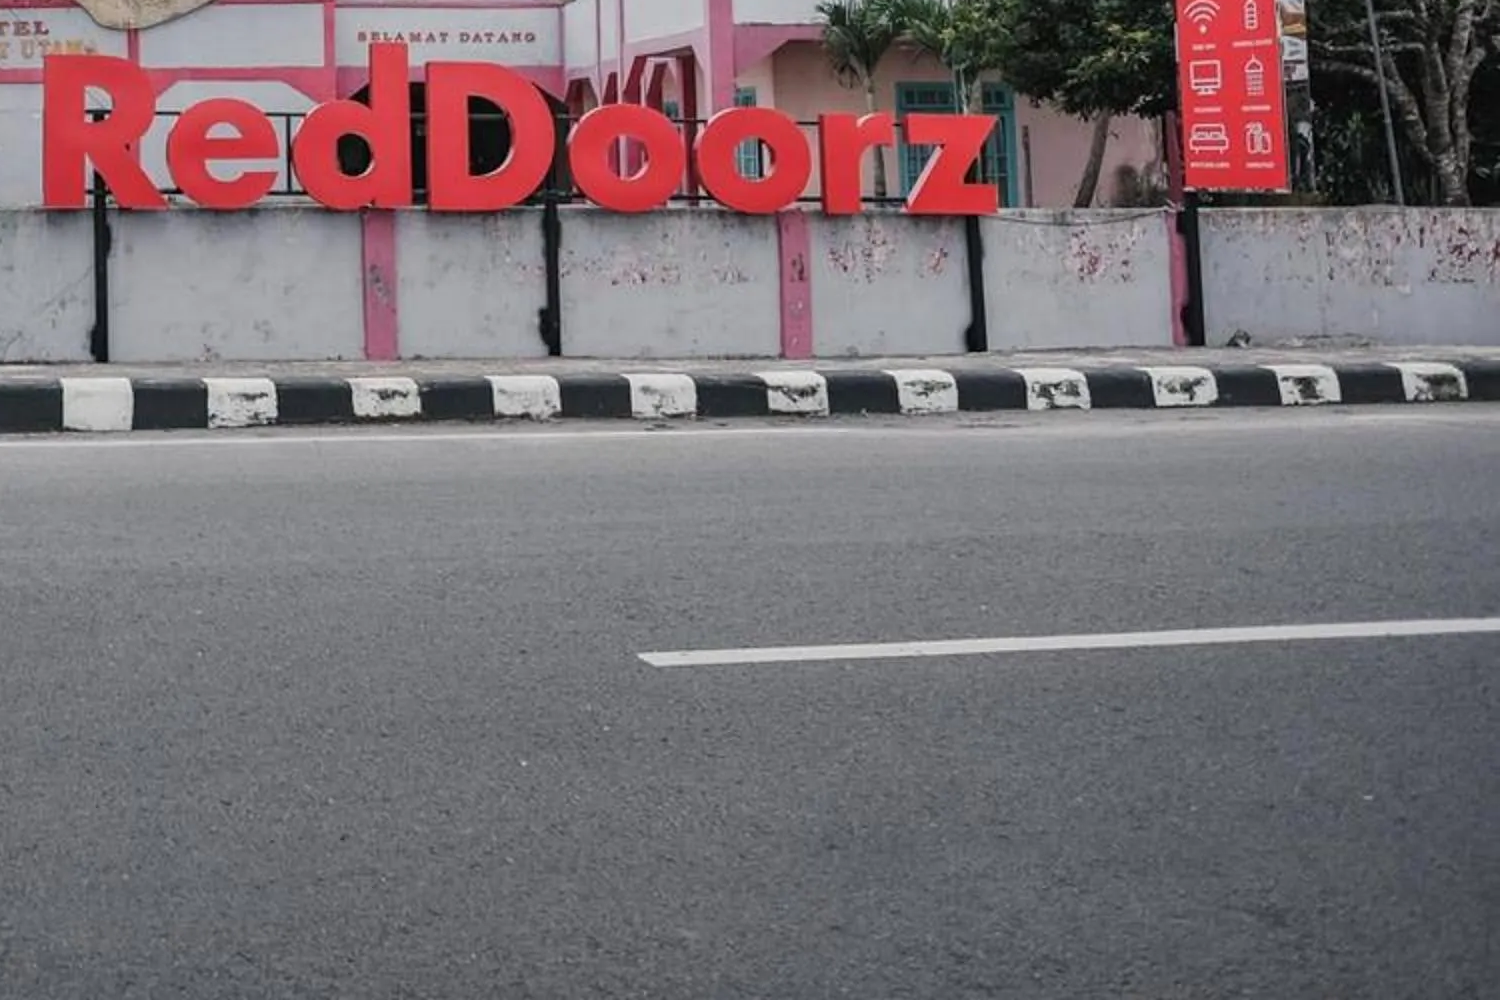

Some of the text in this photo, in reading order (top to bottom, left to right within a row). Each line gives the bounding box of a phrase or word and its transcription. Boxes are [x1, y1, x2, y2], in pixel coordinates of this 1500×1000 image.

[357, 31, 537, 44] SELAMAT DATANG
[21, 39, 99, 60] UTAM
[42, 41, 1000, 214] RedDoorz
